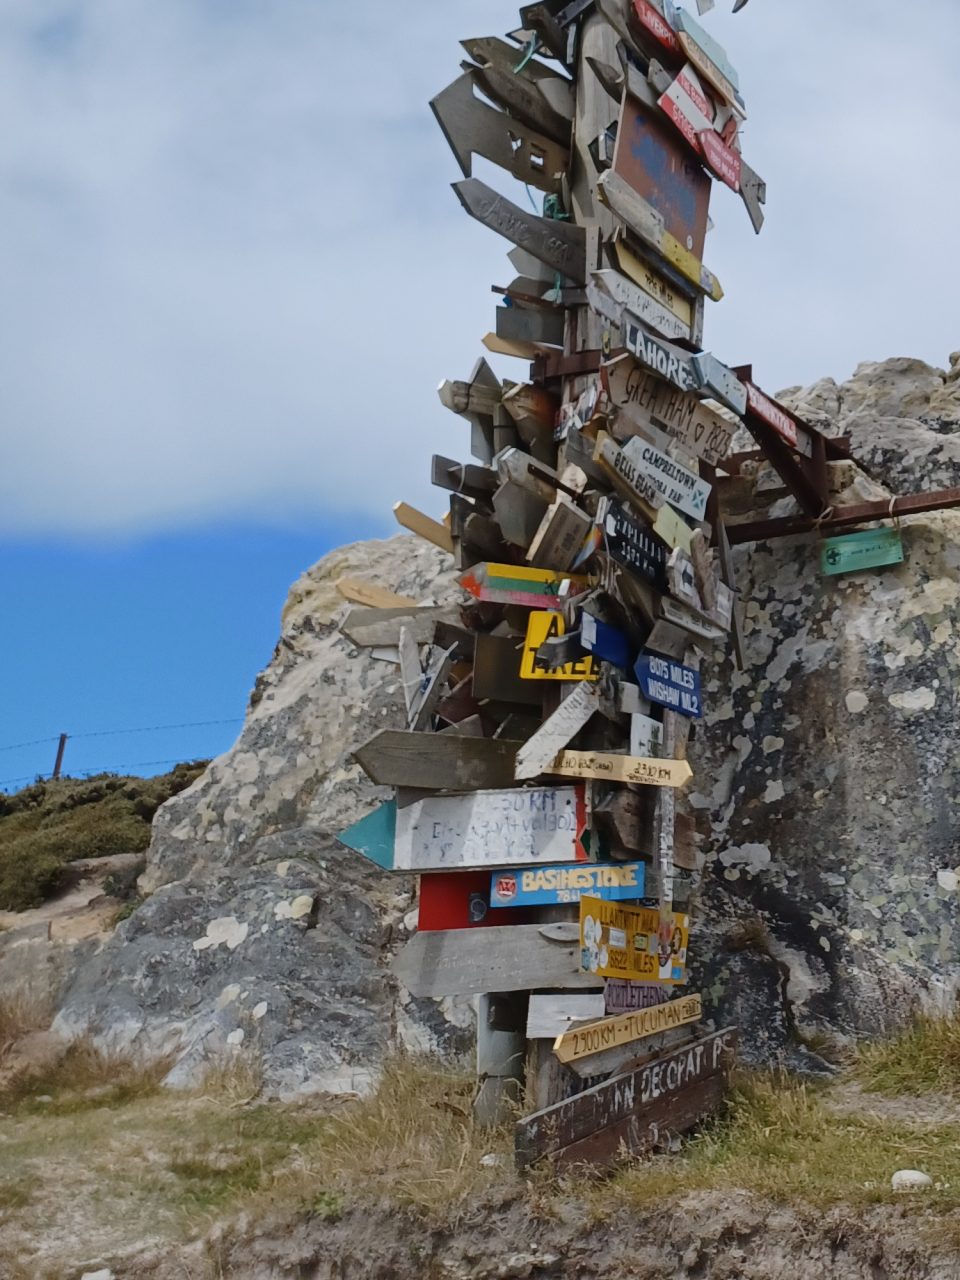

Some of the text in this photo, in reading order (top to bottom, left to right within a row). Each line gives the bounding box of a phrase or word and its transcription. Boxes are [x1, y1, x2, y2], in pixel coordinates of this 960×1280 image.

[626, 320, 690, 392] LAHORE
[705, 421, 732, 458] 7823
[642, 447, 697, 491] CAMPBELTOWN
[647, 677, 699, 713] WISHAW ML2
[670, 664, 695, 690] MILES
[521, 864, 639, 893] BASINGSTOKE
[626, 1003, 681, 1034] TUCUMAN
